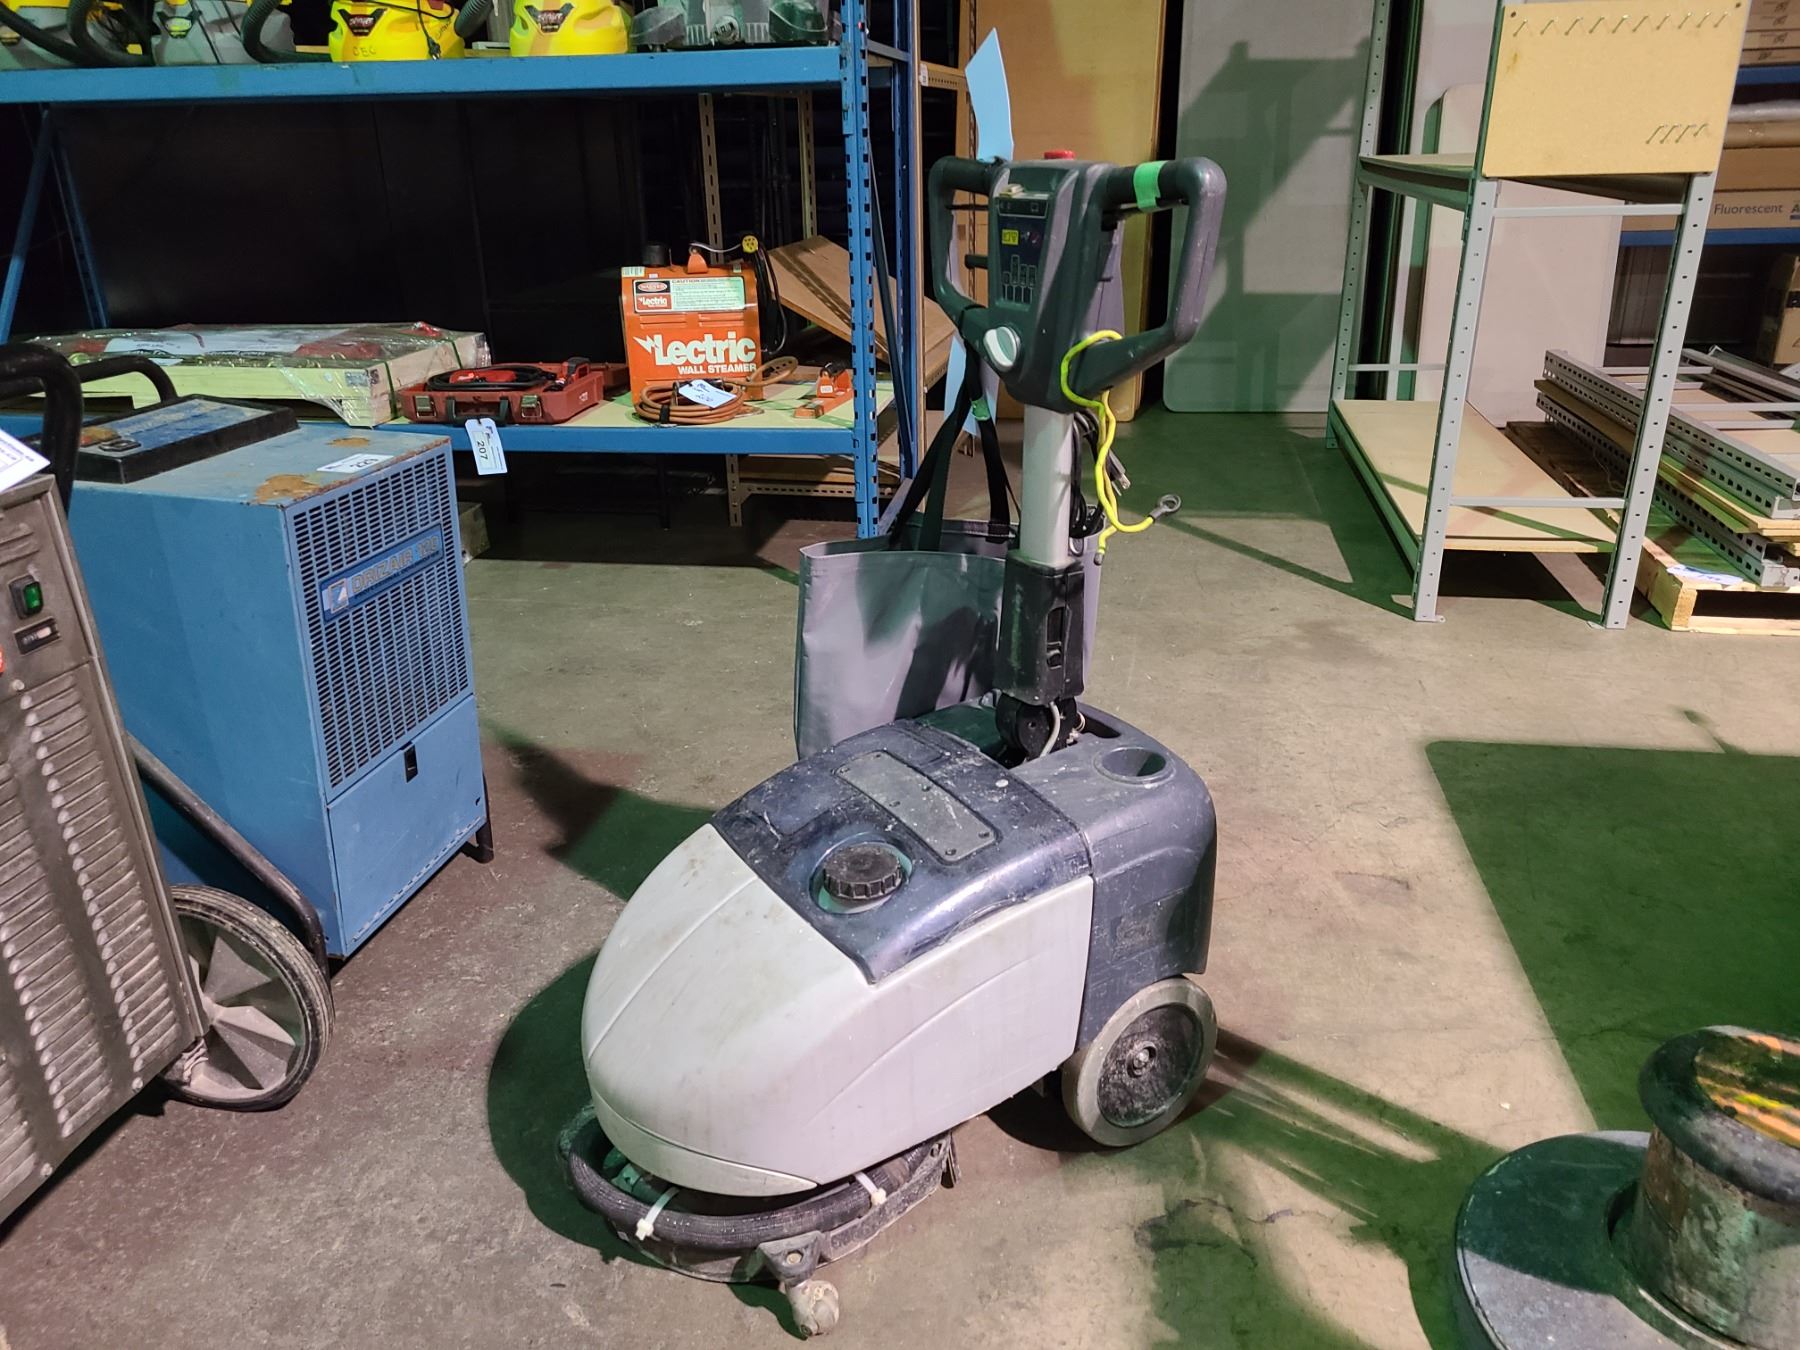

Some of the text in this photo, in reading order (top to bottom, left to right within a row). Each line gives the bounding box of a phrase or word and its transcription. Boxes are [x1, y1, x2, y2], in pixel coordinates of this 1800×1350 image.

[1714, 203, 1784, 215] Fluorescent
[653, 331, 756, 366] Lectric
[678, 363, 757, 375] WALL STEAMER
[477, 440, 488, 460] 207
[352, 549, 413, 593] DRIZAIR
